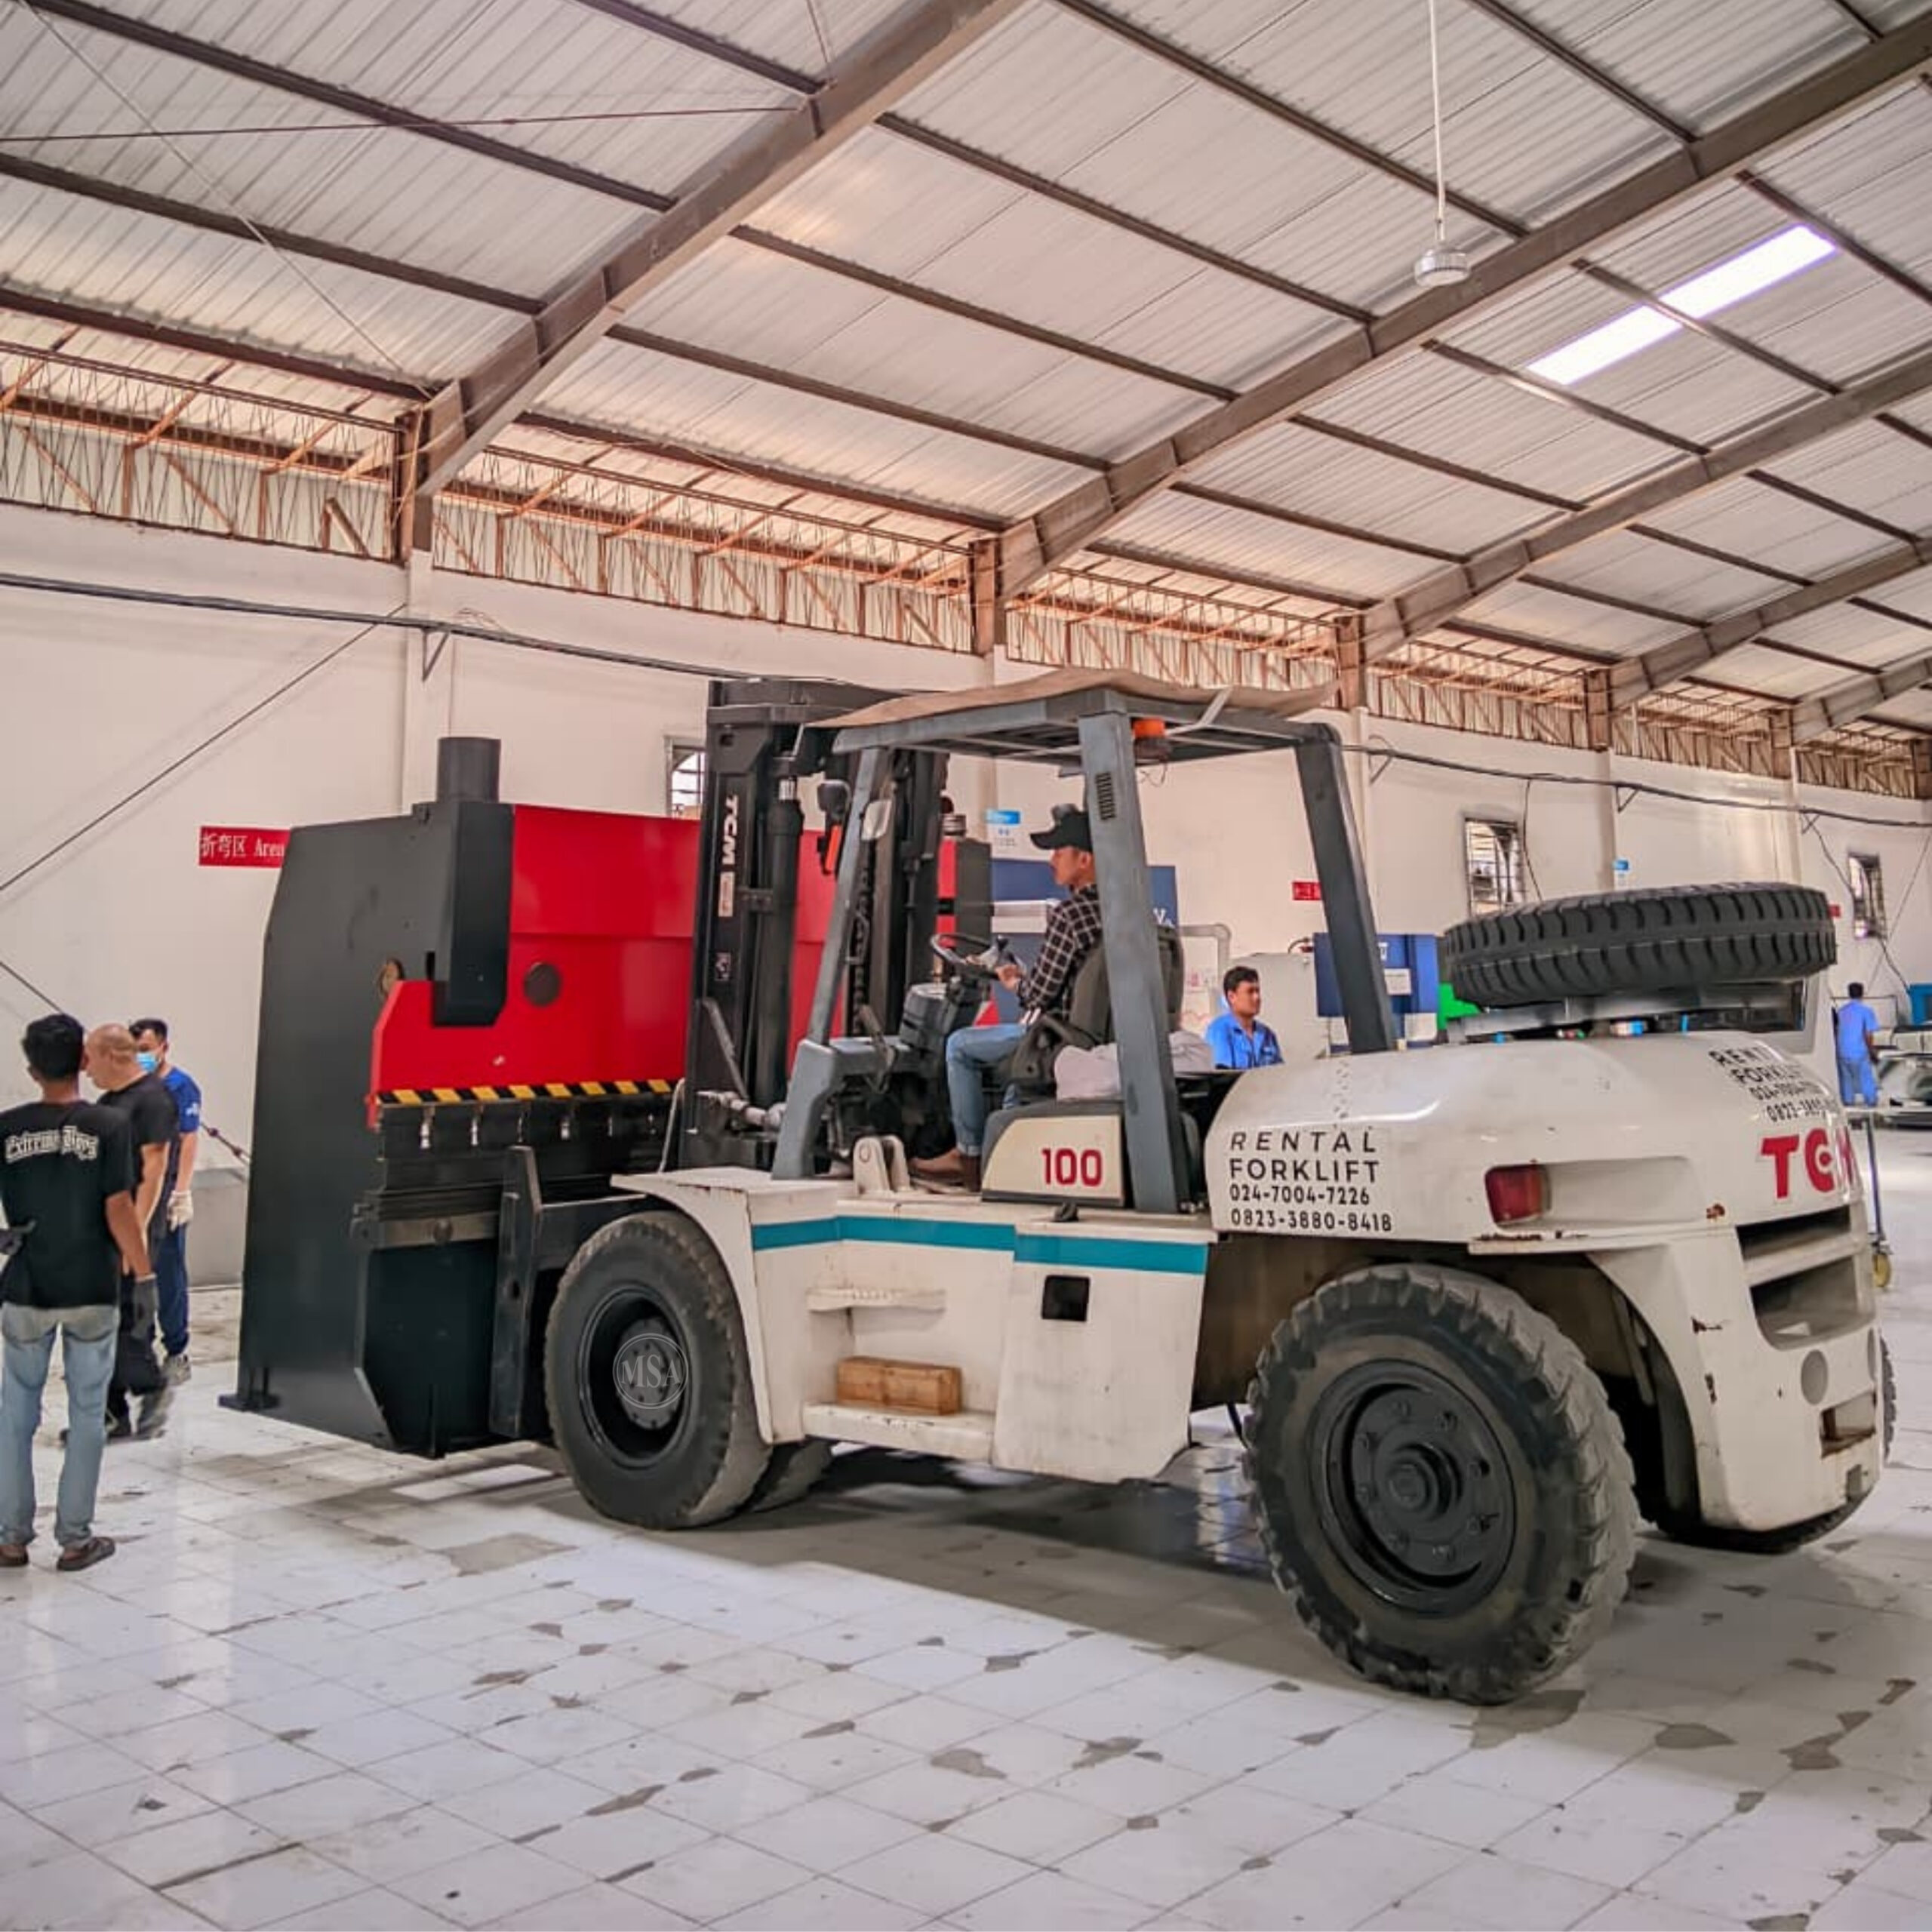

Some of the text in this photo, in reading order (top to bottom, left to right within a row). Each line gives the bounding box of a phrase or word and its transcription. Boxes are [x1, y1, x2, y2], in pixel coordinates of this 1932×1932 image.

[722, 794, 738, 865] TCM
[1230, 1131, 1377, 1153] RENTAL
[1041, 1147, 1103, 1187] 100
[1229, 1158, 1380, 1183] FORKLIFT
[1229, 1183, 1370, 1205] 024-7004-7226
[1231, 1208, 1392, 1232] 0823-3880-8418
